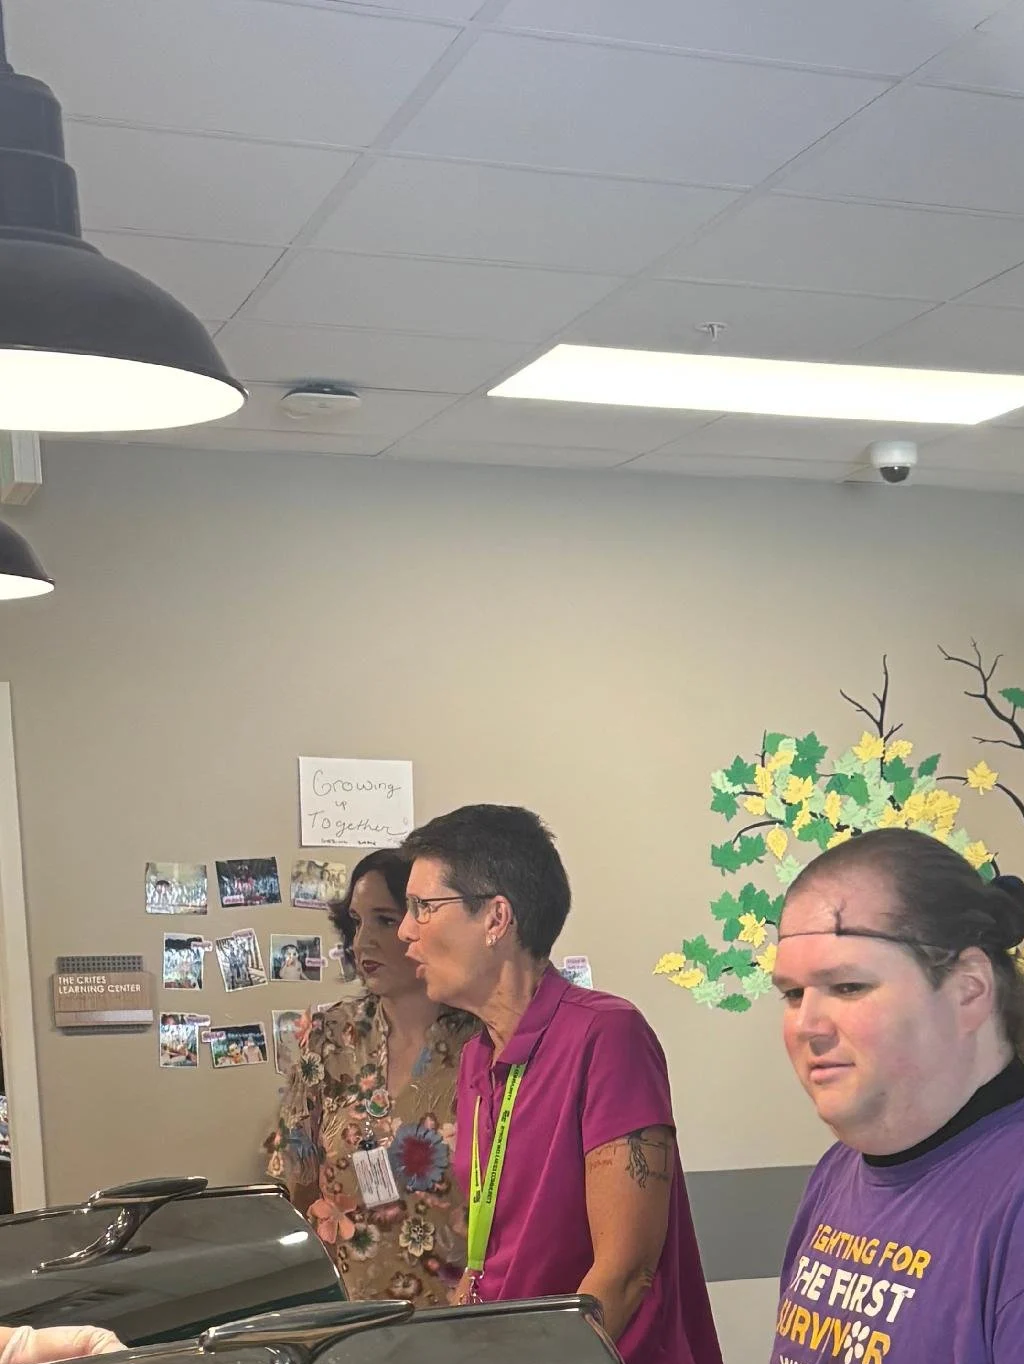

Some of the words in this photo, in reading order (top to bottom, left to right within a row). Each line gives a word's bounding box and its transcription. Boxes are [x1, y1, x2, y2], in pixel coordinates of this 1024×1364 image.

[312, 769, 402, 799] Growing
[335, 801, 347, 810] up
[58, 976, 75, 985] THE
[77, 975, 107, 985] CRITES
[58, 985, 105, 994] LEARNING
[107, 984, 141, 993] CENTER
[809, 1223, 881, 1265] IGHTING
[878, 1241, 932, 1279] FOR
[790, 1255, 832, 1301] THE
[829, 1268, 915, 1323] FIRST
